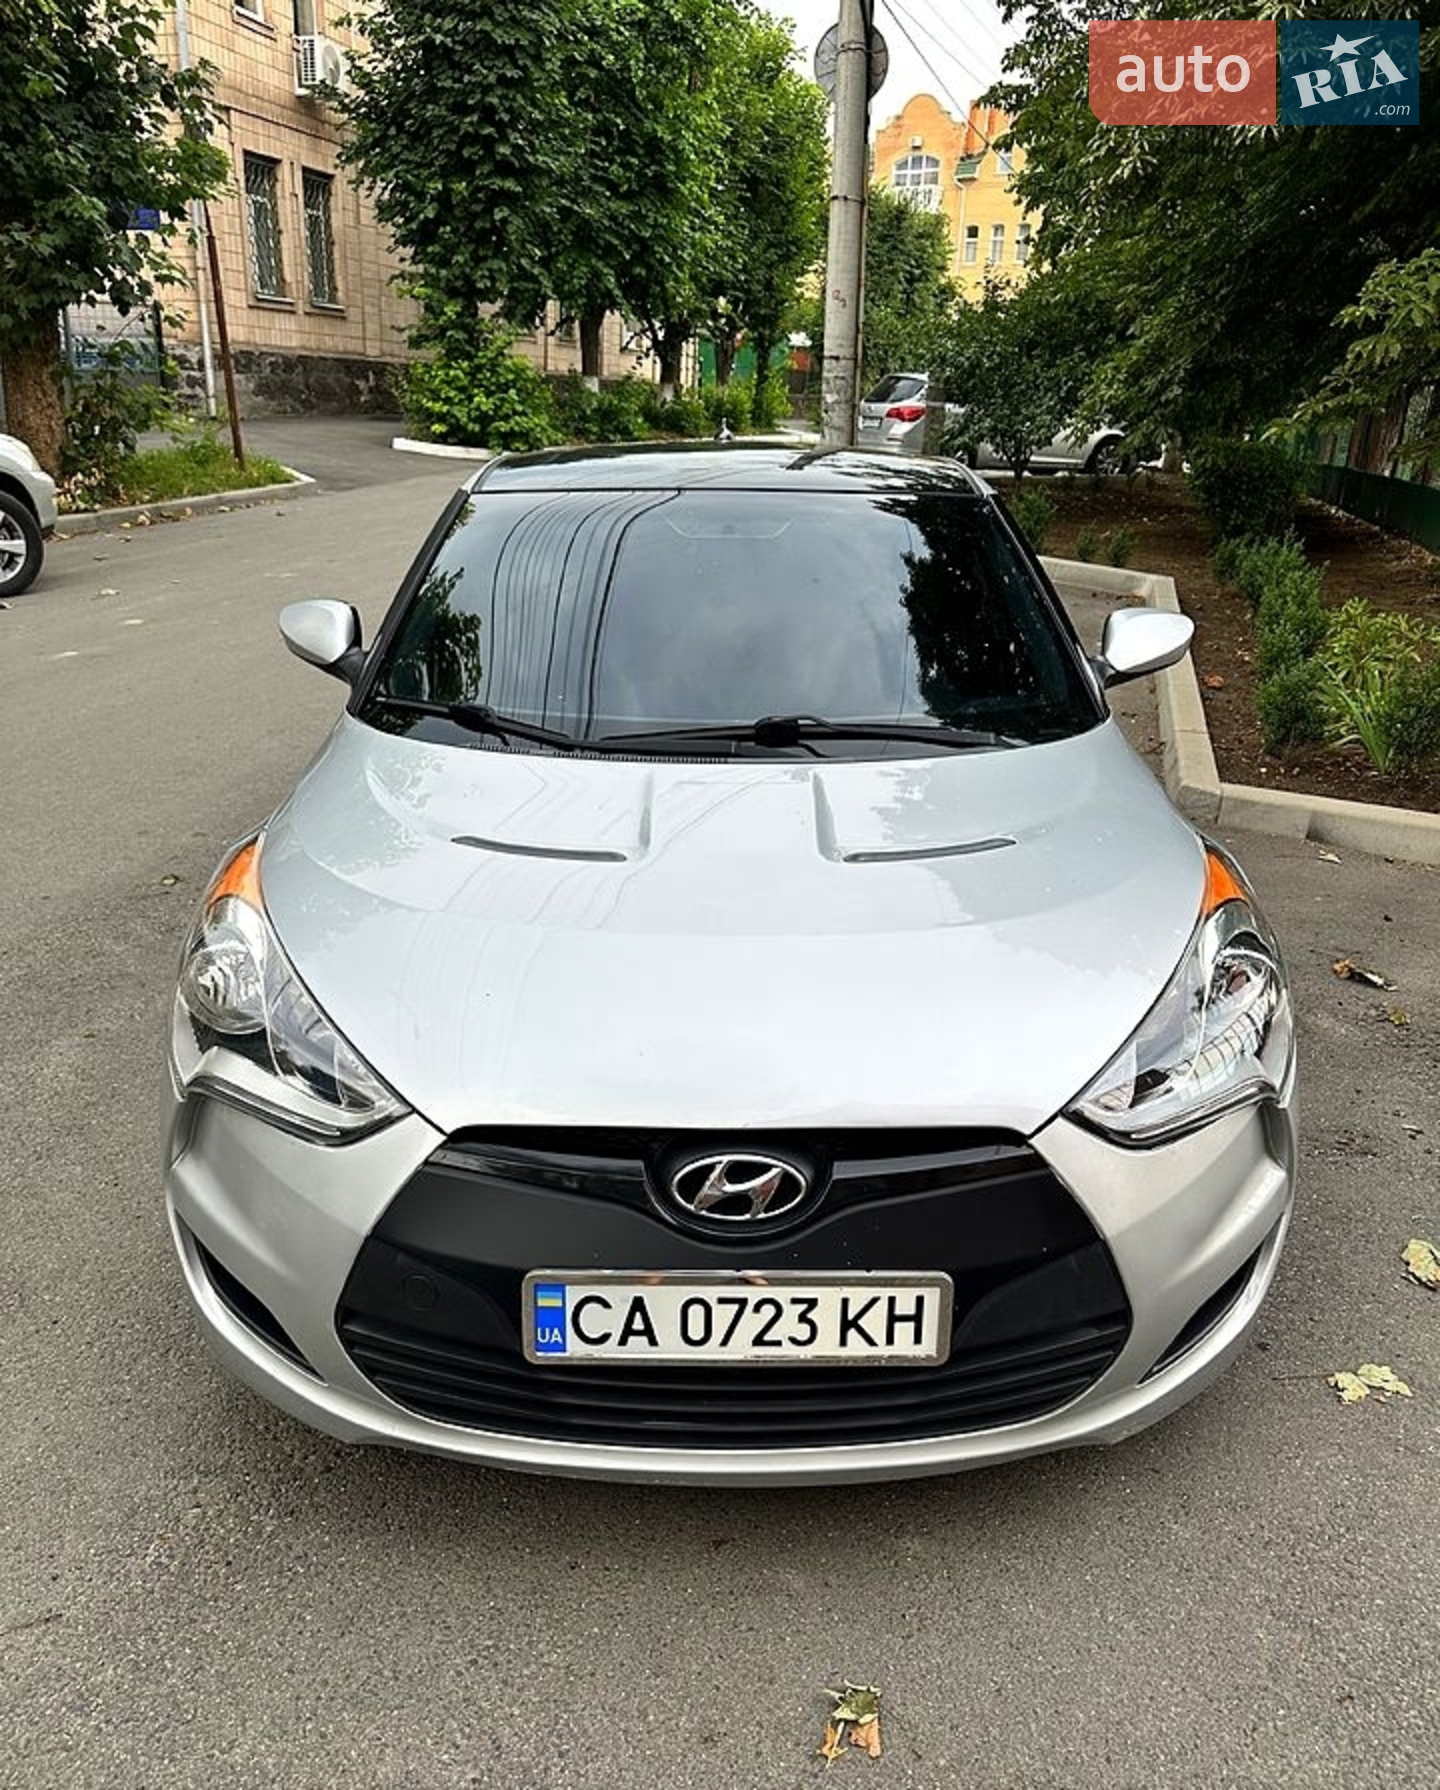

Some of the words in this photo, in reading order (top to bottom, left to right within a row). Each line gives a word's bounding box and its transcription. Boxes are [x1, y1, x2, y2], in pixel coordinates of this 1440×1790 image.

[537, 1327, 563, 1344] UA
[571, 1295, 659, 1346] CA
[679, 1296, 819, 1347] 0723
[838, 1295, 925, 1347] KH
